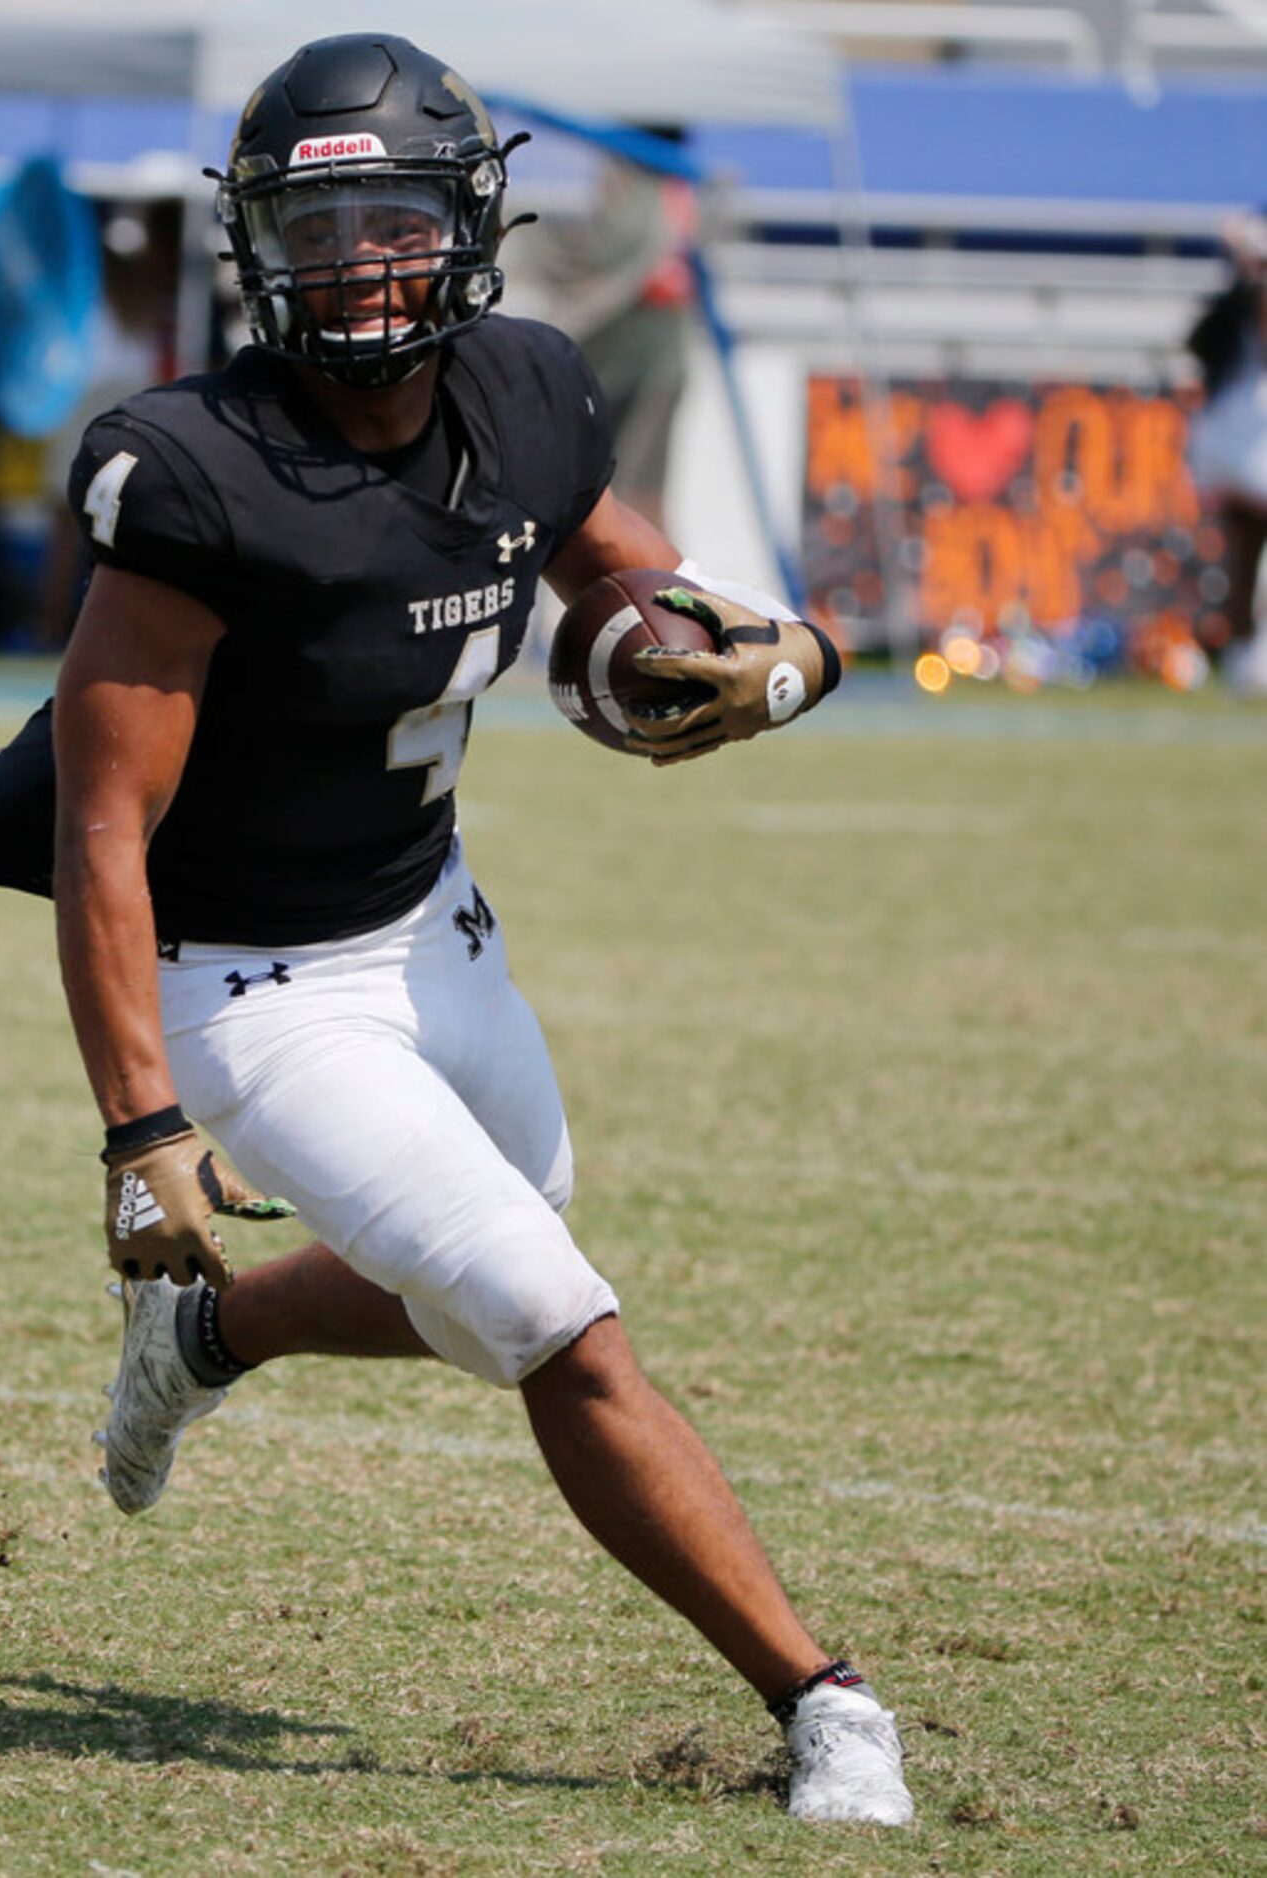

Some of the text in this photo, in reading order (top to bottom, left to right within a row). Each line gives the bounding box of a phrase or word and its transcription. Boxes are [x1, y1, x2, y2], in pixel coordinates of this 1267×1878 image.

[299, 138, 372, 159] Riddell
[83, 450, 139, 549] 4
[408, 577, 516, 634] TIGERS
[386, 623, 501, 808] 4
[451, 882, 497, 962] M
[115, 1170, 137, 1241] adidas
